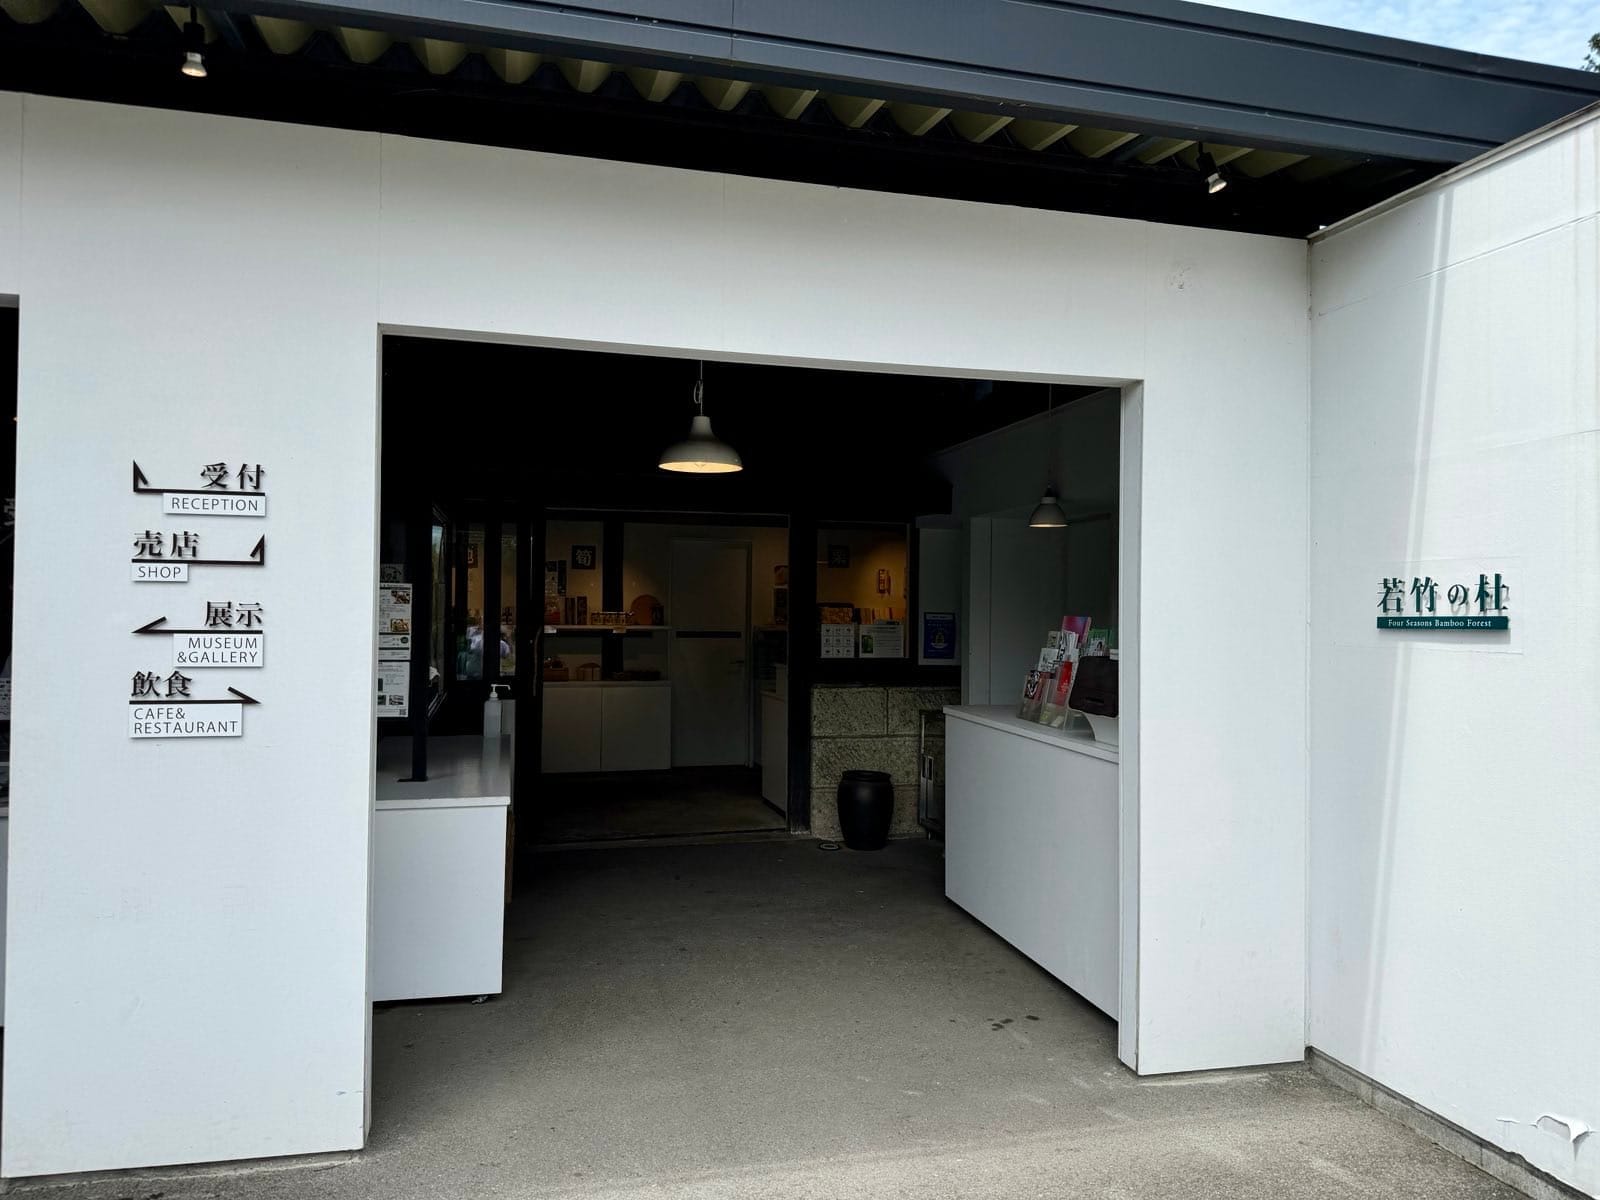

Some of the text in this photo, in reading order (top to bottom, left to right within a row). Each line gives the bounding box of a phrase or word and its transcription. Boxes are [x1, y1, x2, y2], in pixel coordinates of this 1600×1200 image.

[200, 462, 265, 490] 受付
[171, 497, 259, 512] RECEPTION
[133, 530, 200, 558] 売店
[138, 566, 182, 579] SHOP
[1377, 573, 1509, 613] 若竹の杜
[204, 601, 264, 628] 展示
[1388, 619, 1492, 627] Four Seasons Bamboo Forest
[188, 637, 258, 650] MUSEUM
[176, 651, 259, 664] &GALLERY
[131, 670, 193, 698] 飲食
[133, 707, 186, 720] CAFE&
[133, 721, 239, 735] RESTAURANT
